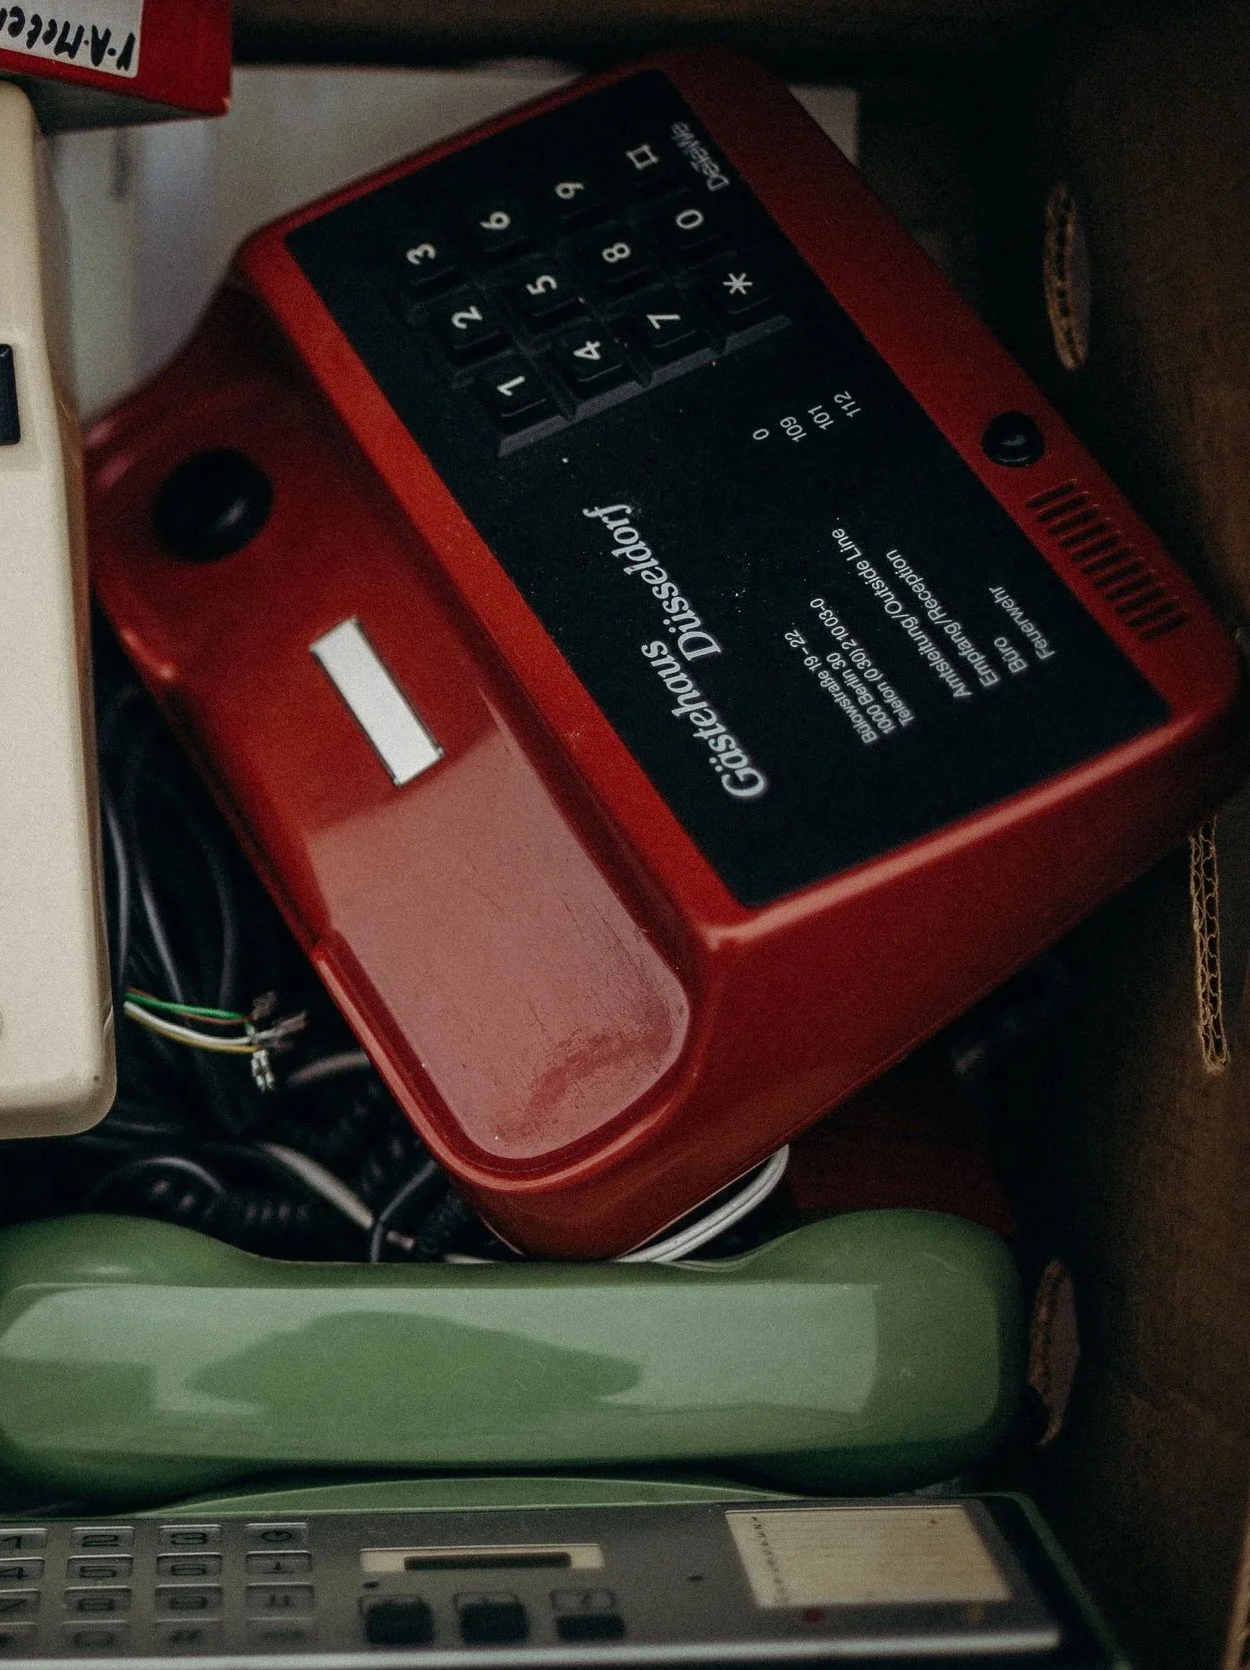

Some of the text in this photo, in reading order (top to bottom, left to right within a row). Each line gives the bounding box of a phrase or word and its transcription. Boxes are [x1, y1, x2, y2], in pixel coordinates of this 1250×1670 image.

[676, 209, 704, 230] 0
[555, 182, 680, 330] 7 8 9
[480, 211, 601, 362] 4 5 6
[406, 242, 525, 396] 1 2 3
[807, 404, 834, 430] 101
[834, 390, 862, 417] 112
[752, 428, 770, 440] 0
[780, 416, 806, 442] 109
[832, 528, 862, 561] Line
[582, 504, 723, 661] Düsseldorf
[988, 586, 1056, 660] Feuerwehr
[994, 637, 1028, 674] Büro
[818, 670, 878, 744] Bülowstraße
[826, 653, 896, 734] 1000 Berlin 30
[877, 682, 915, 726] Telefon
[641, 640, 766, 798] Gästehaus
[3, 1532, 208, 1548] 1 2 3
